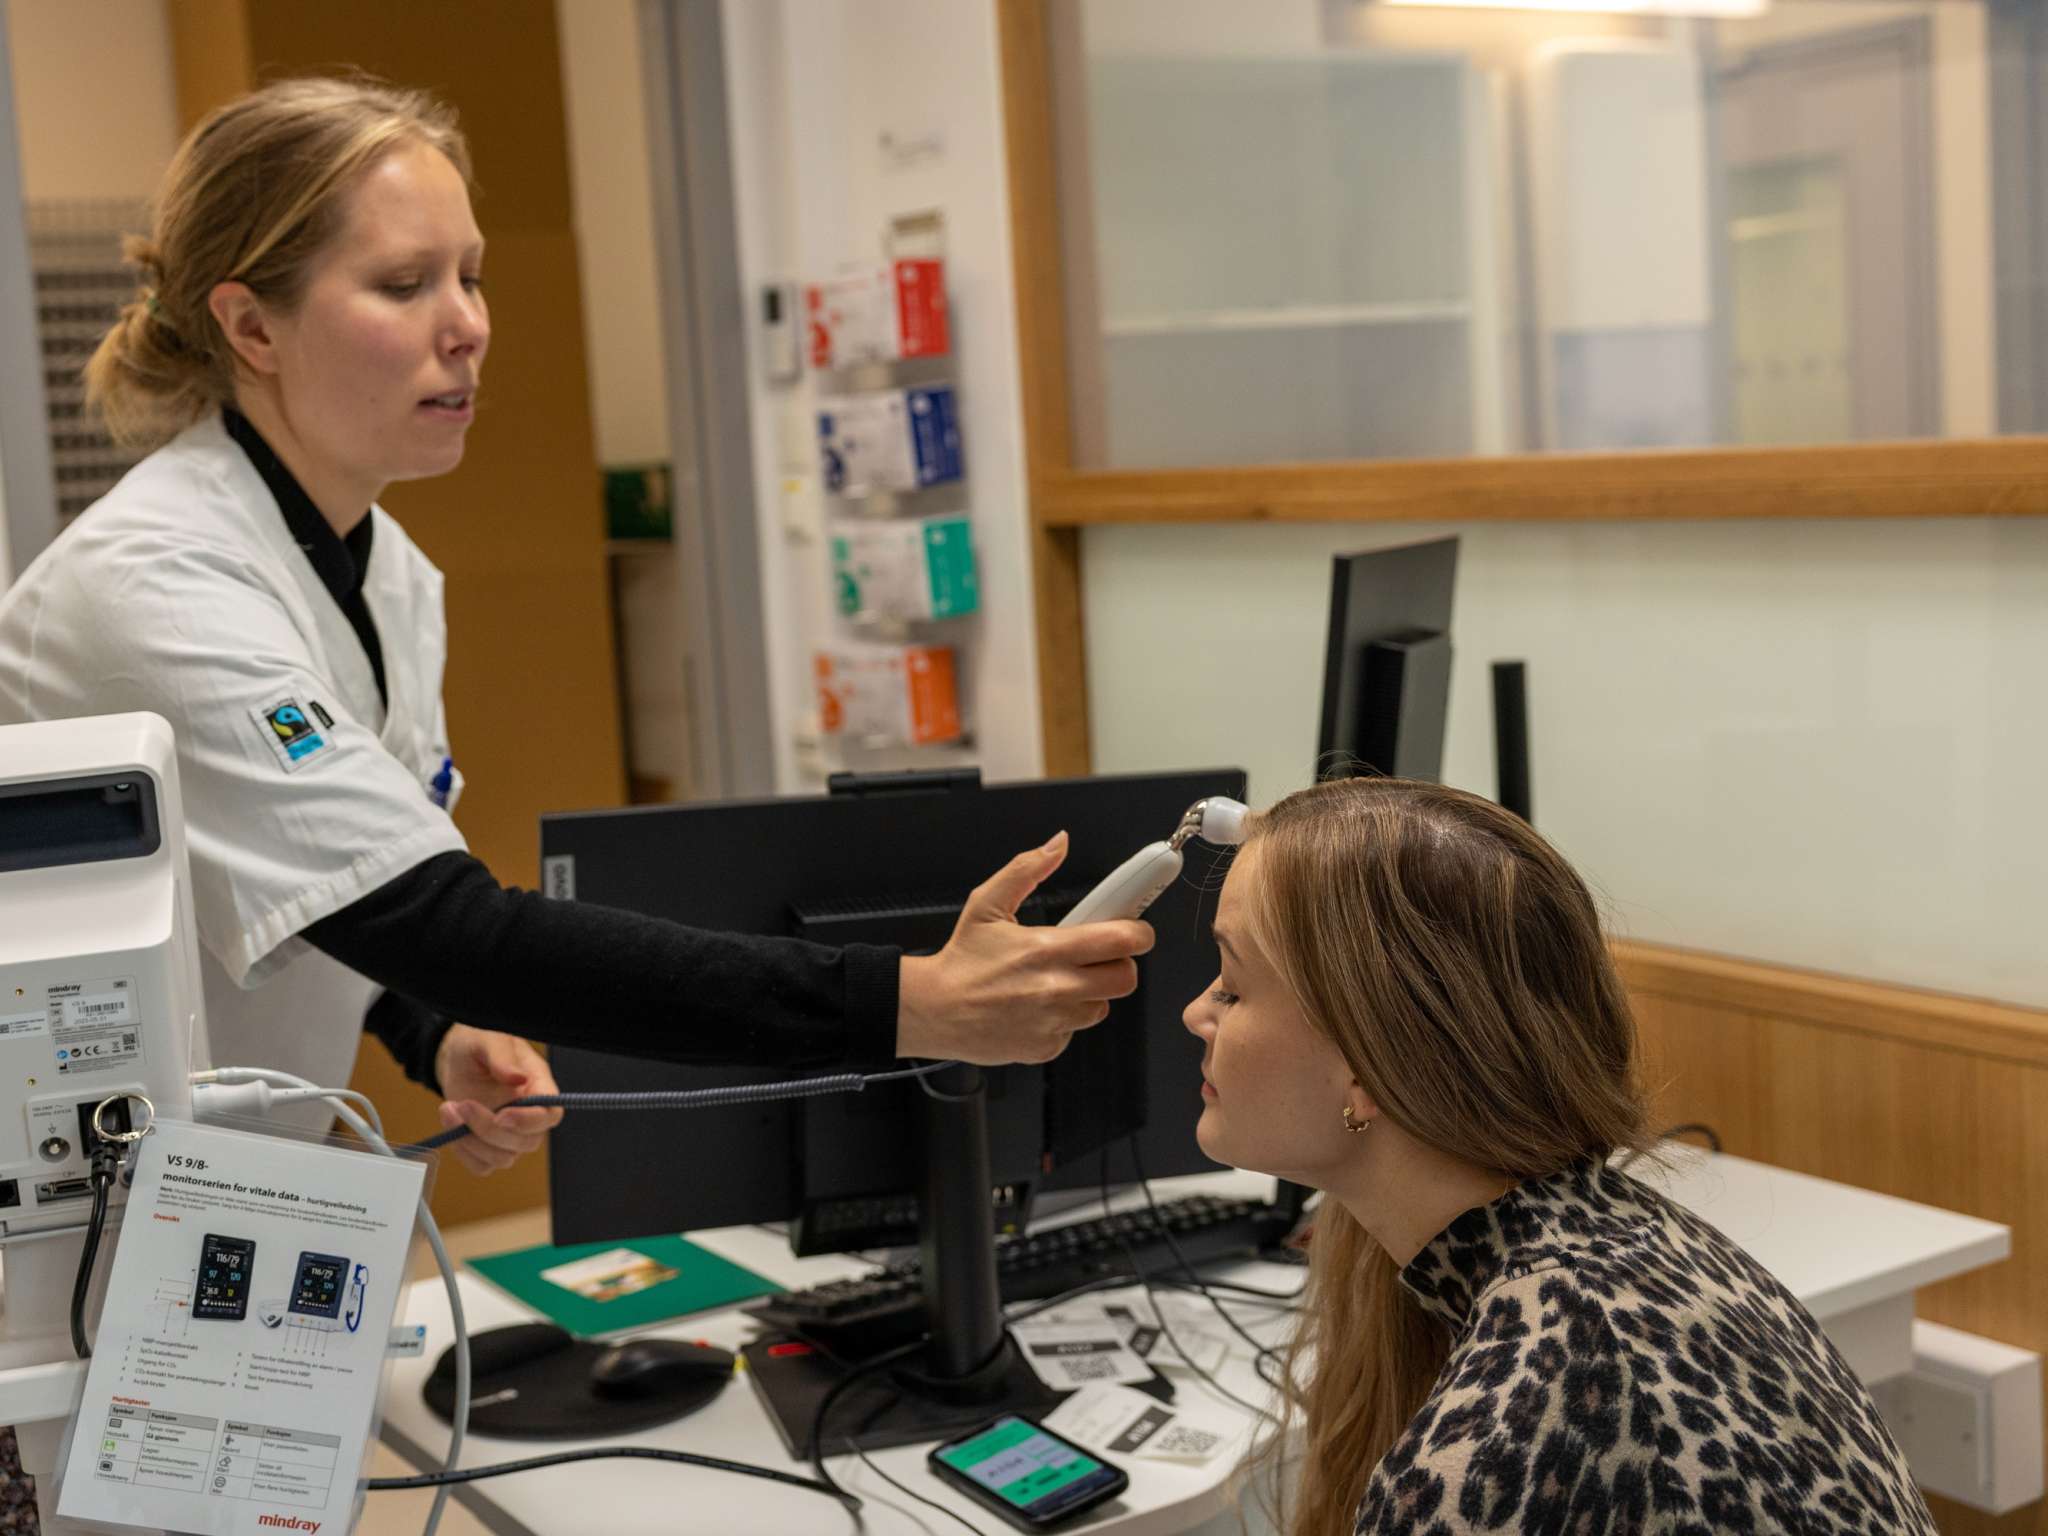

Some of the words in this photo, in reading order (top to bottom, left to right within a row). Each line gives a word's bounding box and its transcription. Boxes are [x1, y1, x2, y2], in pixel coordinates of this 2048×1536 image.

[166, 1154, 182, 1166] VS
[184, 1158, 209, 1170] 9/8-
[162, 1172, 231, 1189] monitorserien
[232, 1183, 247, 1192] for
[248, 1186, 276, 1197] vitale
[277, 1190, 300, 1201] data
[258, 1511, 321, 1534] mindray
